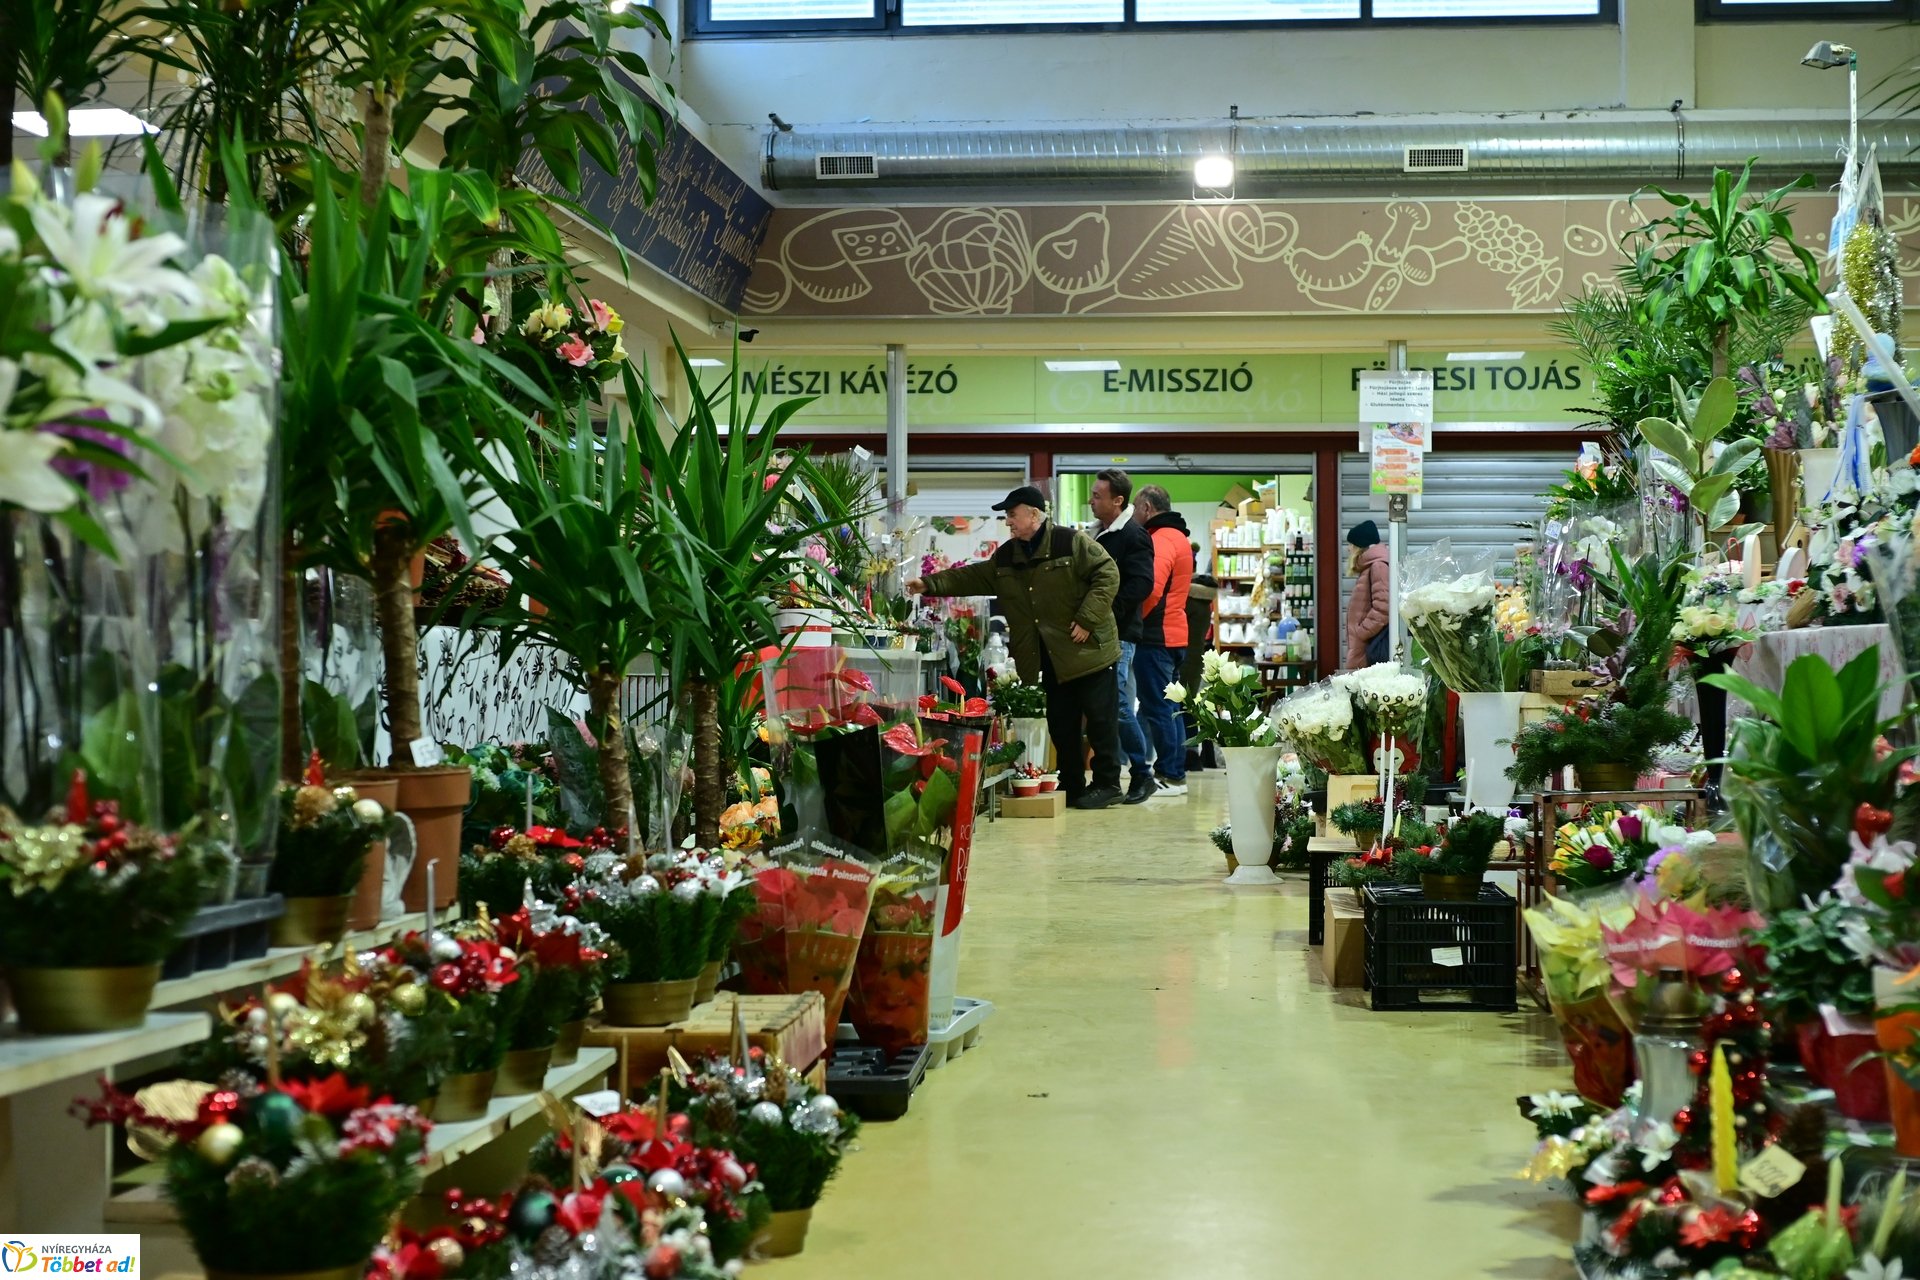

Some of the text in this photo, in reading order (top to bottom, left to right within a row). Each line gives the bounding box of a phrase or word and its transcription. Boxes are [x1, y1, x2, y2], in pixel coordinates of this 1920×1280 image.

[1103, 361, 1253, 392] E-MISSZIÓ
[1351, 359, 1582, 391] FESI TOJÁS
[832, 868, 870, 883] Poinsettia
